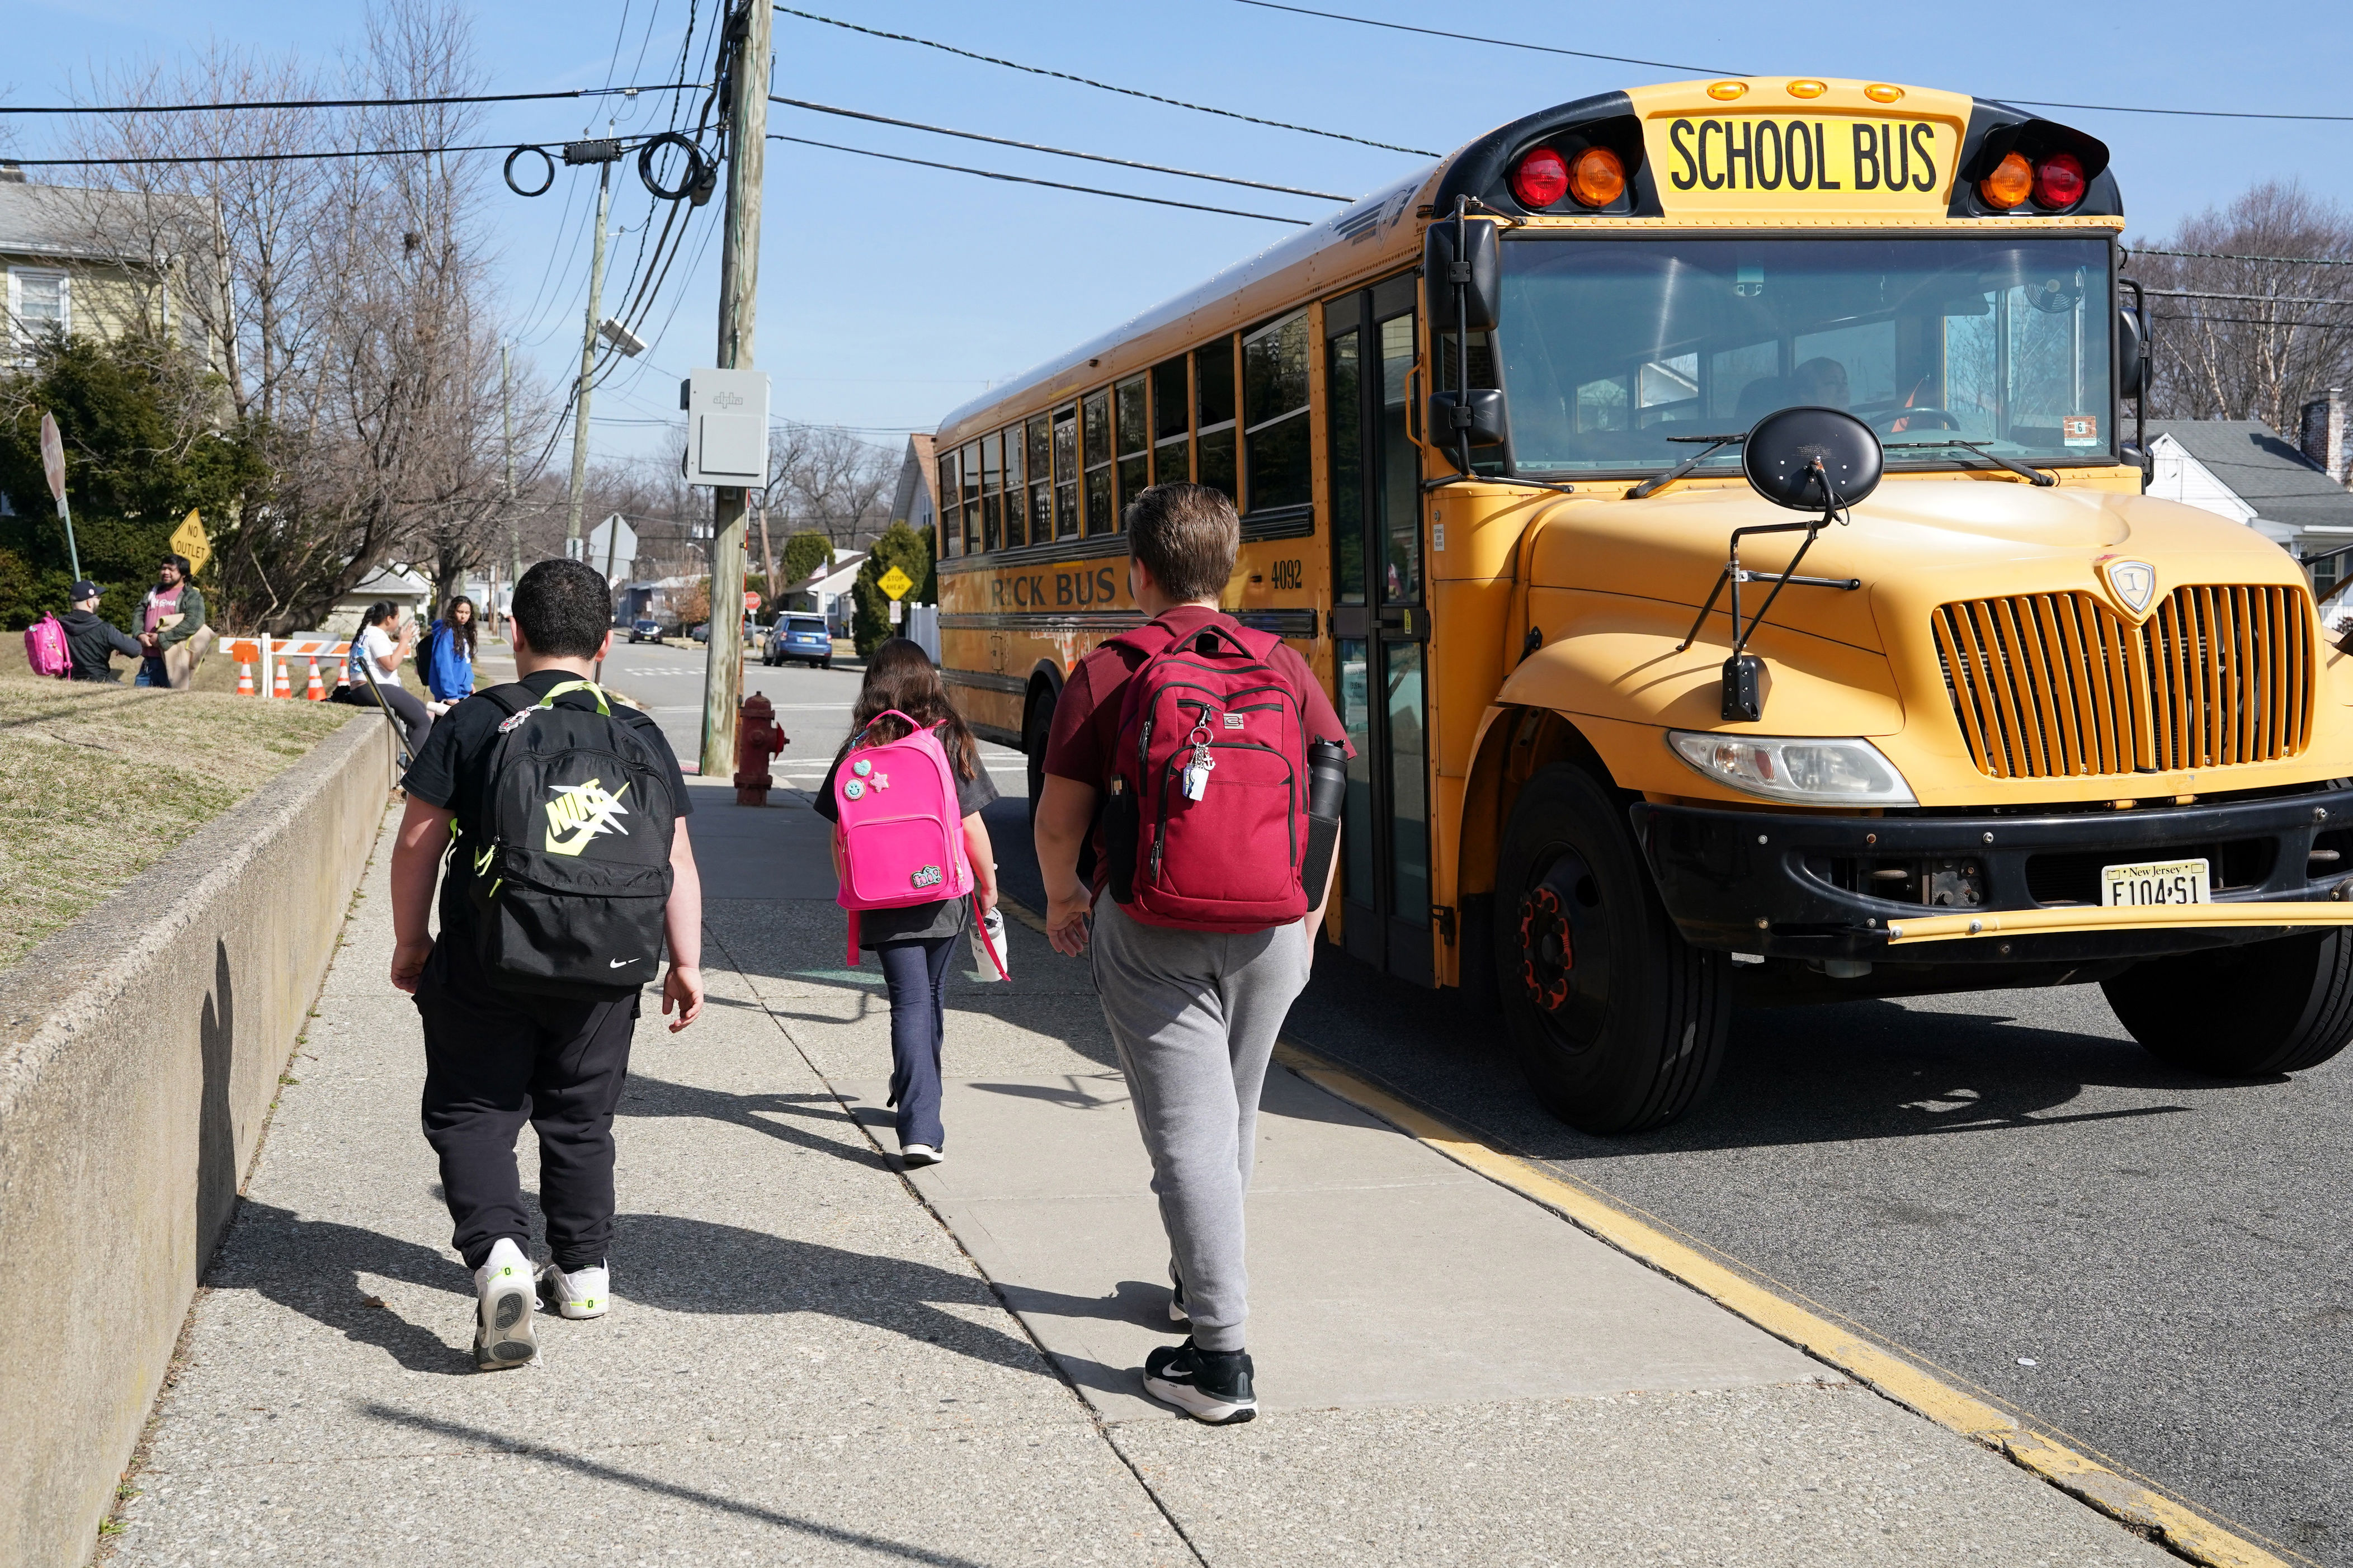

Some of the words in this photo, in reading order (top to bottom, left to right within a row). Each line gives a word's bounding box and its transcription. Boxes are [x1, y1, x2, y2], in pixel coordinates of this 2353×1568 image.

[1670, 118, 1841, 191] SCHOOL
[1852, 122, 1937, 192] BUS
[713, 391, 743, 409] alpha
[2078, 422, 2082, 432] 6
[187, 524, 198, 538] NO
[176, 540, 205, 559] OUTLET
[1271, 560, 1302, 589] 4092
[991, 575, 1047, 607] RICK
[1055, 566, 1116, 606] BUS
[745, 597, 760, 605] STOP
[545, 778, 607, 837] NIKE
[2129, 867, 2151, 877] New
[2152, 866, 2182, 877] Jersey
